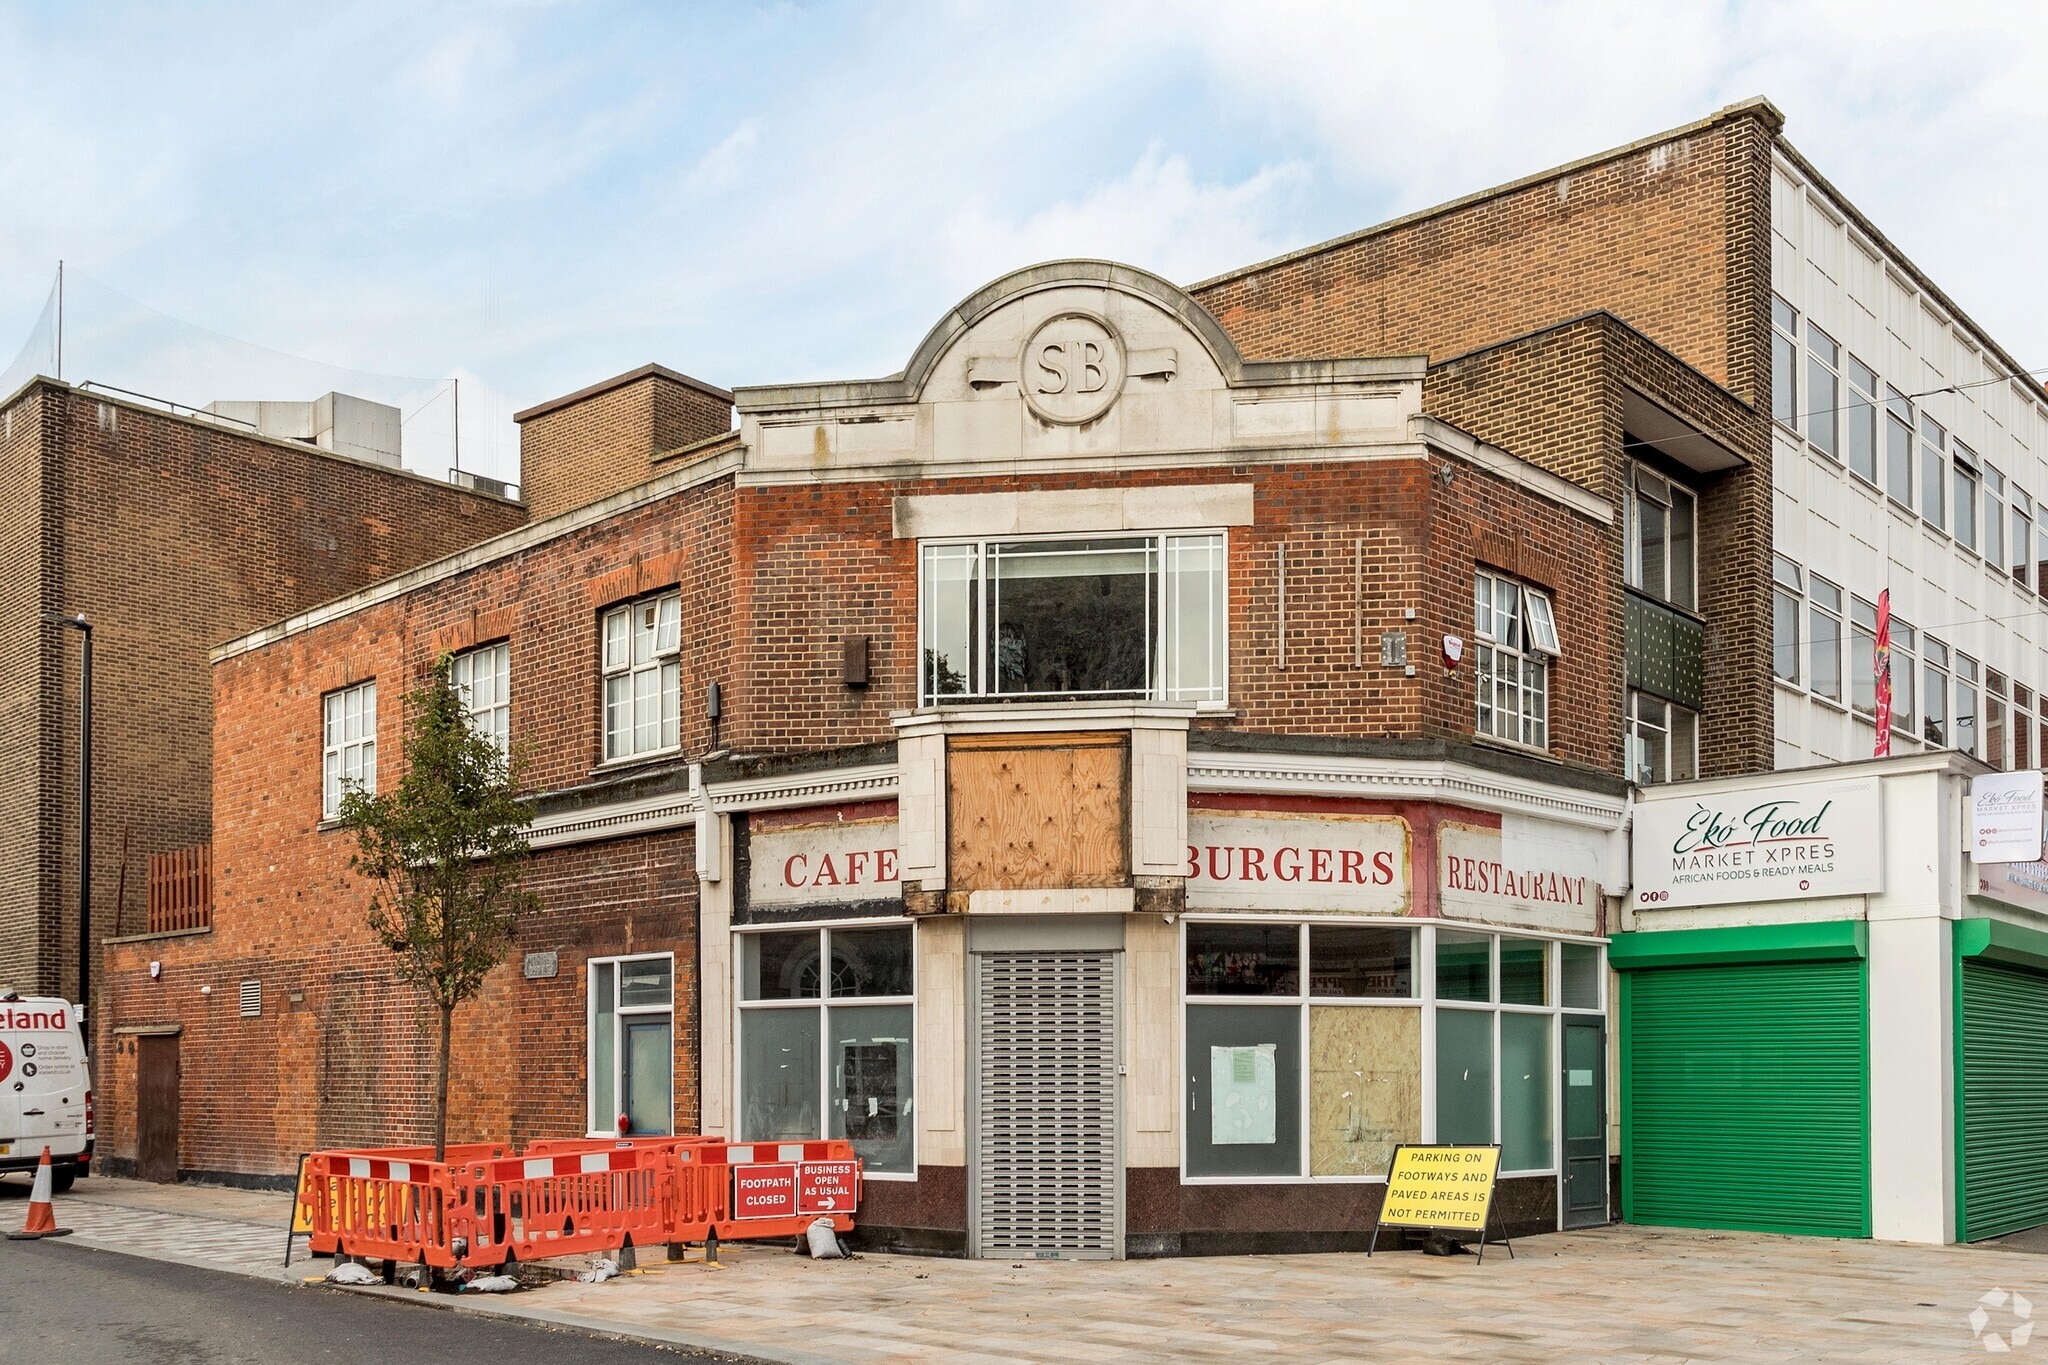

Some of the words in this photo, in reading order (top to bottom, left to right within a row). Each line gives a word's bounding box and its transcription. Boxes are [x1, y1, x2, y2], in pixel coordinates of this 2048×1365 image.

[1037, 341, 1109, 394] SB
[2003, 789, 2036, 804] Food
[1743, 800, 1832, 847] Food
[1672, 850, 1755, 872] MARKET
[1766, 843, 1834, 863] XPRES
[784, 848, 899, 888] CAFE
[1672, 872, 1714, 884] AFRICAN
[1716, 869, 1752, 881] FOODS
[1753, 868, 1760, 878] &
[1762, 865, 1796, 877] READY
[1798, 862, 1834, 873] MEALS
[1447, 855, 1586, 906] RESTAURANT
[1411, 1152, 1460, 1163] PARKING
[1464, 1153, 1482, 1163] ON
[804, 1165, 851, 1175] BUSINESS
[740, 1177, 792, 1189] FOOTPATH
[814, 1176, 839, 1185] OPEN
[1397, 1171, 1458, 1182] FOOTWAYS
[1462, 1173, 1488, 1183] AND
[804, 1187, 817, 1196] AS
[819, 1186, 850, 1195] USUAL
[1391, 1189, 1428, 1200] PAVED
[1431, 1191, 1469, 1202] AREAS
[1473, 1192, 1486, 1202] IS
[746, 1194, 786, 1206] CLOSED
[1387, 1208, 1412, 1218] NOT
[1415, 1210, 1480, 1222] PERMITTED
